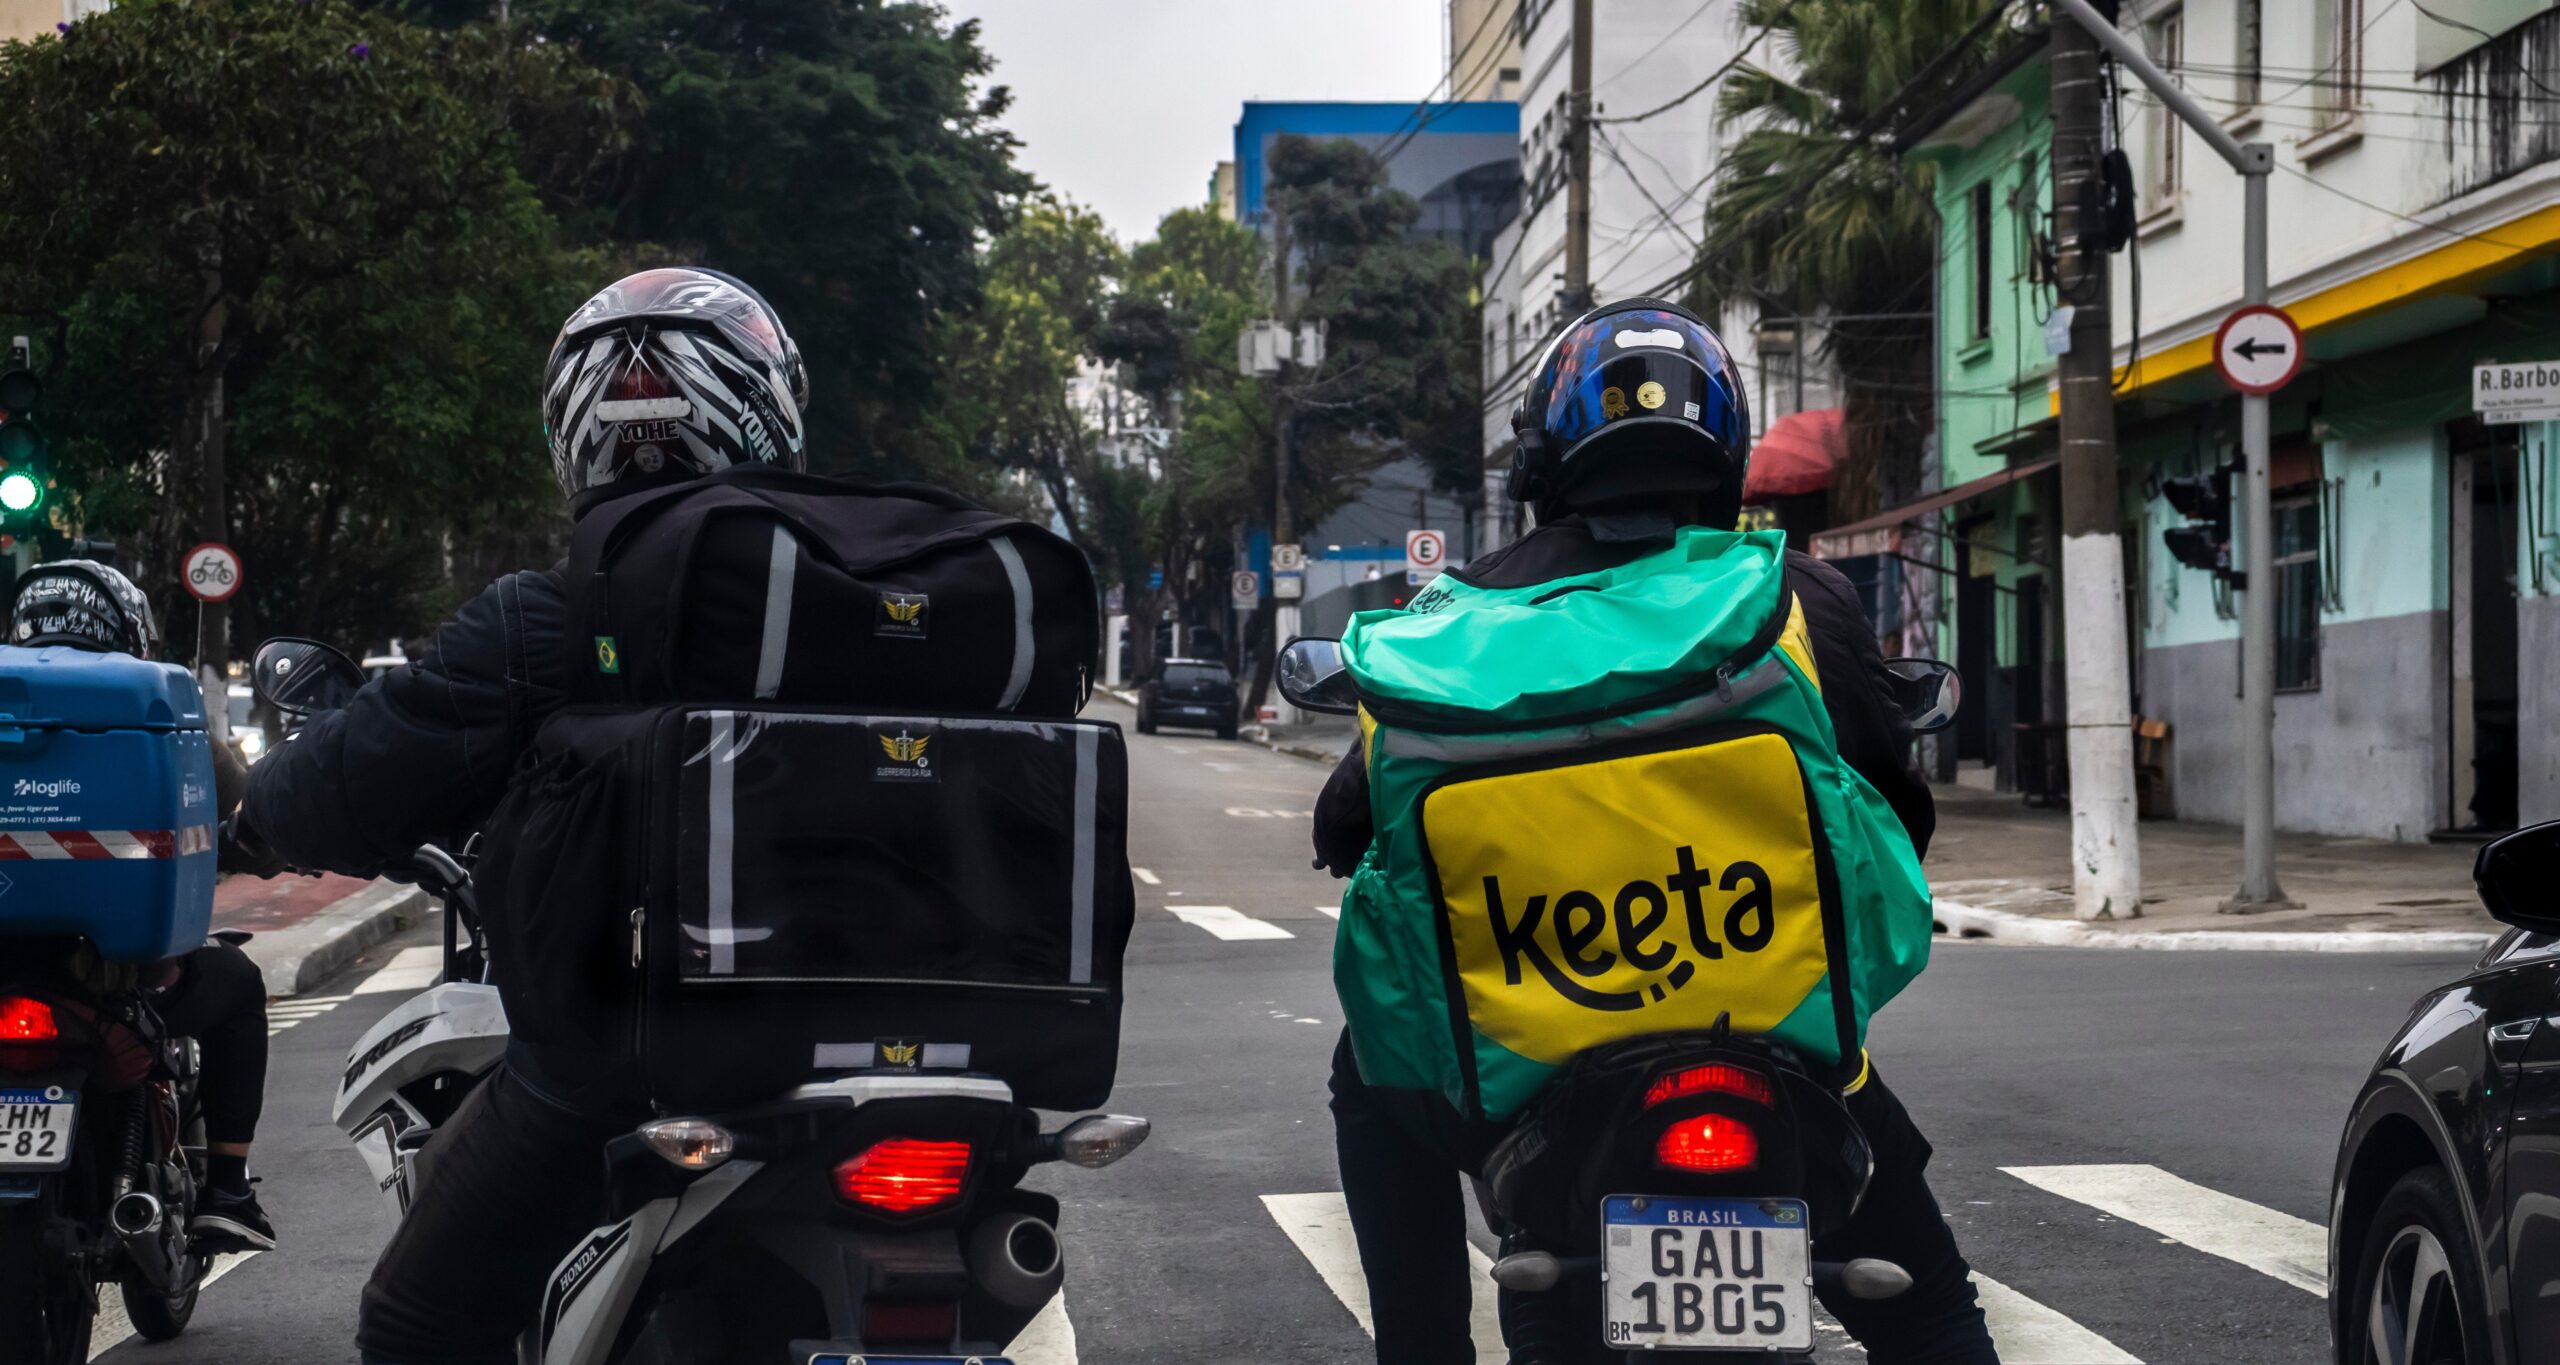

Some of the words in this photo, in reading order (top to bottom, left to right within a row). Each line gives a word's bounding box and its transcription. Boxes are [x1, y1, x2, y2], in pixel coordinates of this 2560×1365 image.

[615, 419, 680, 443] YOHE
[737, 402, 778, 465] YOHE
[1282, 550, 1291, 564] E
[1420, 540, 1431, 558] E
[1241, 578, 1249, 590] E
[1409, 586, 1456, 614] eeta
[32, 779, 81, 797] loglife
[1483, 845, 1774, 1011] keeta
[379, 1163, 404, 1194] 160
[1667, 1209, 1742, 1225] BRASIL
[1651, 1228, 1764, 1279] GAU
[559, 1244, 599, 1292] HONDA
[1631, 1281, 1785, 1335] 1B05
[1609, 1321, 1631, 1342] BR
